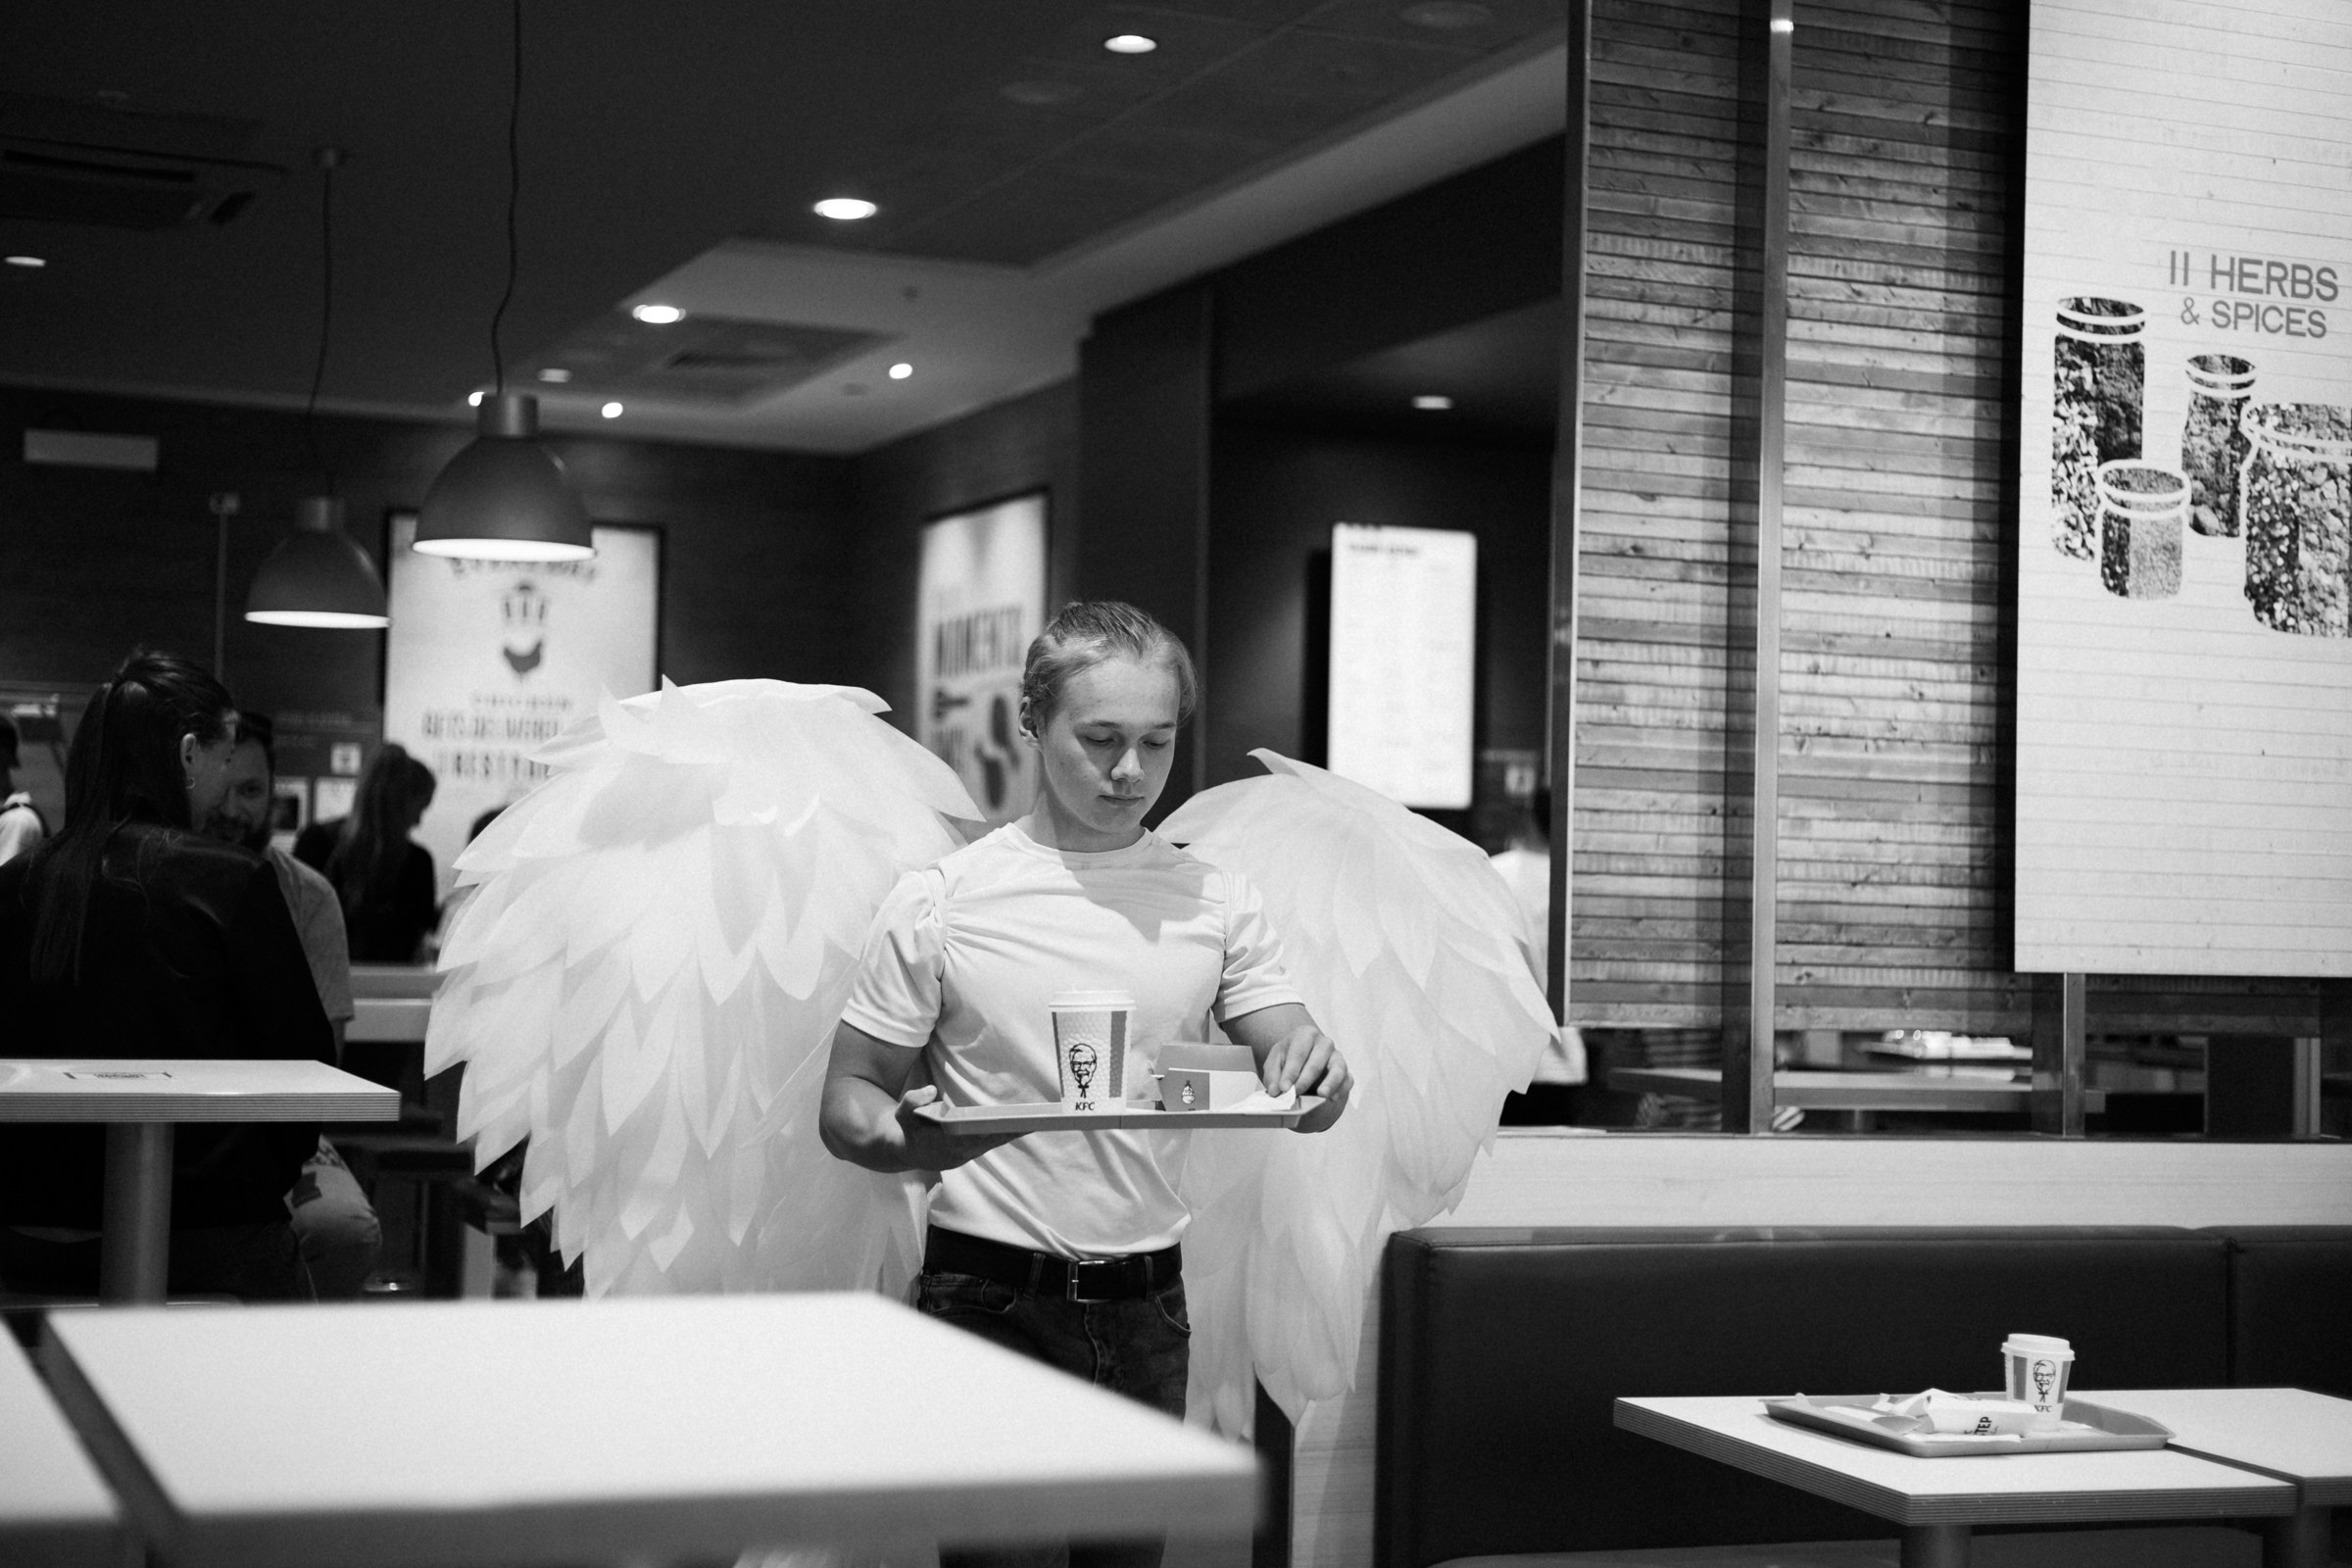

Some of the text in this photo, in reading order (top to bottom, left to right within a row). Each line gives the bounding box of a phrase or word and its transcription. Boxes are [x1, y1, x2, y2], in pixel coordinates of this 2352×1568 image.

[2211, 254, 2339, 302] HERBS
[2180, 296, 2328, 339] & SPICES
[1075, 1102, 1096, 1111] KFC
